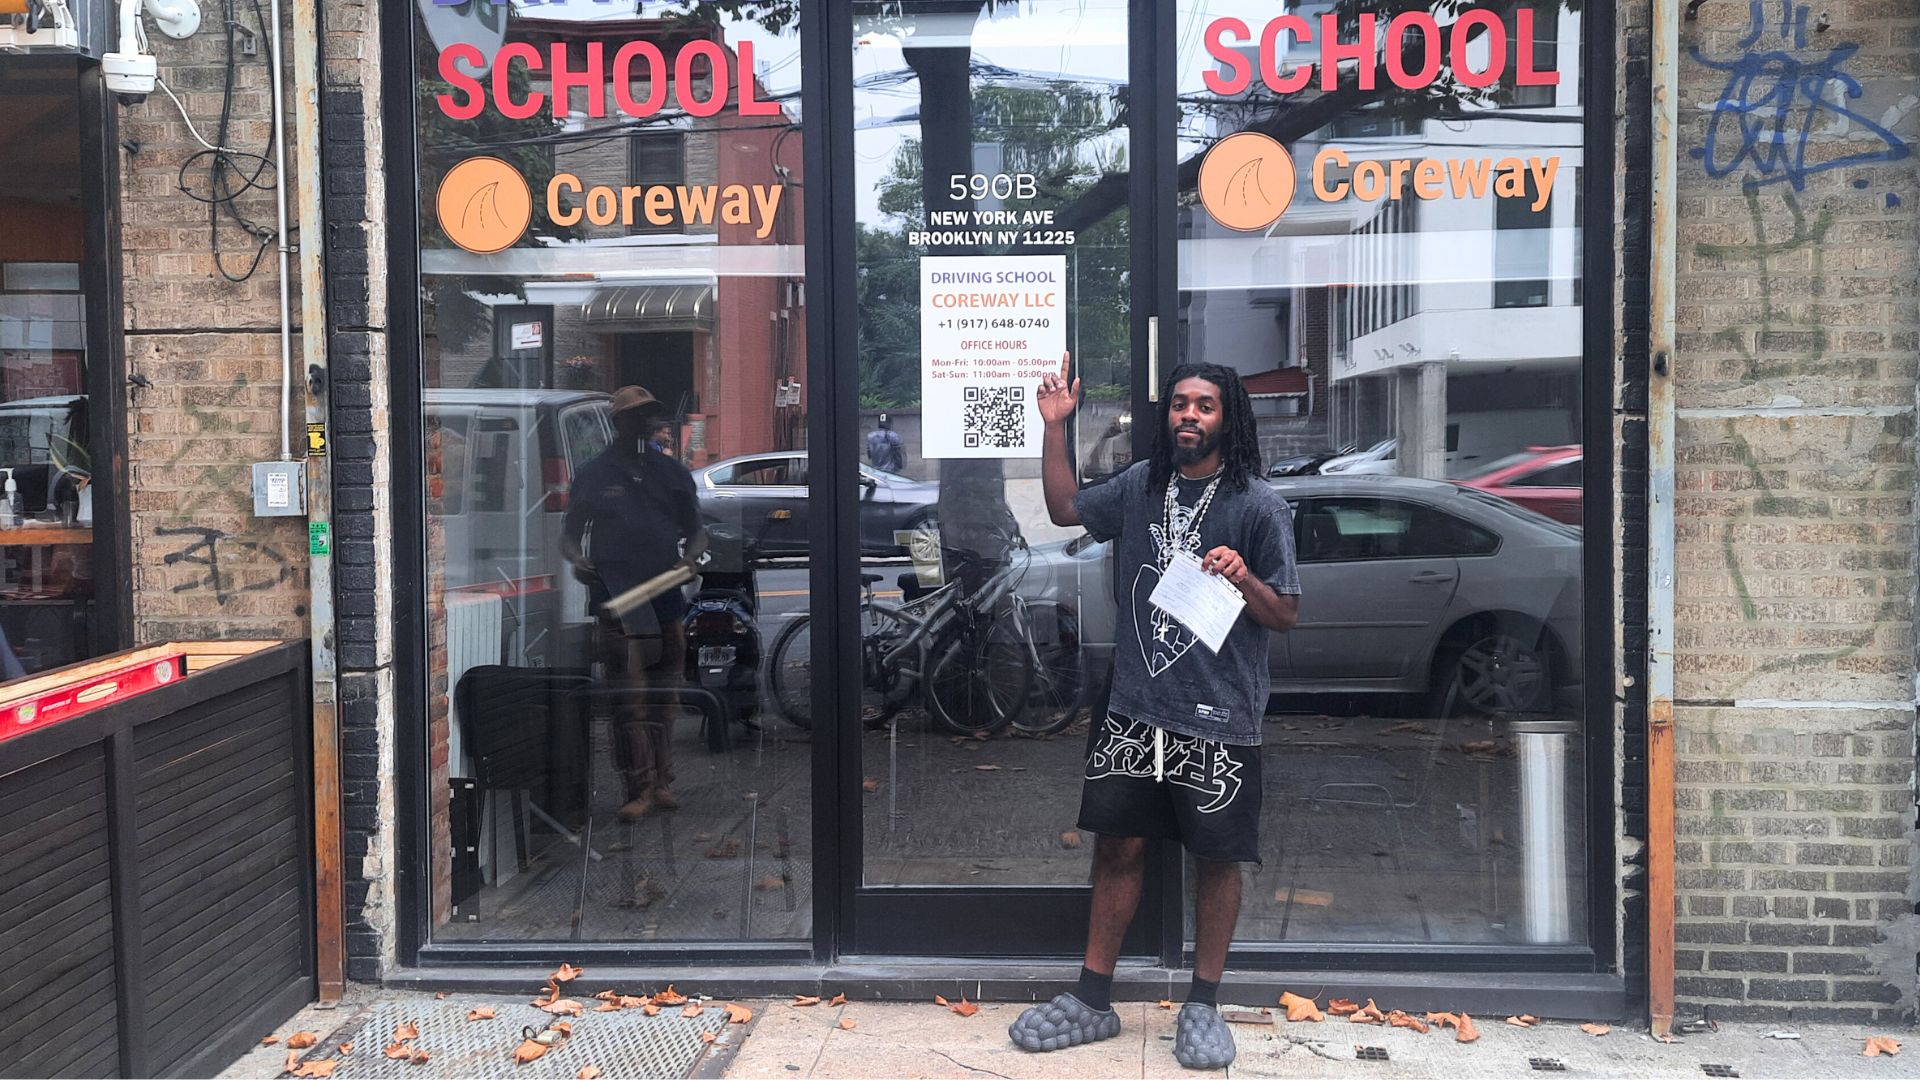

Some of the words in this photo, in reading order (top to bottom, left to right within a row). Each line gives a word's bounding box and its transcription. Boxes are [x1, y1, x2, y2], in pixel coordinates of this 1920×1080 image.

[1202, 8, 1560, 95] SCHOOL
[436, 39, 781, 120] SCHOOL
[950, 173, 1037, 200] 590B
[1312, 148, 1560, 212] Coreway
[547, 173, 783, 239] Coreway
[930, 211, 968, 226] NEW
[972, 210, 1018, 225] YORK
[1022, 210, 1054, 225] AVE
[908, 231, 993, 245] BROOKLYN
[997, 231, 1020, 245] NY
[1022, 230, 1075, 245] 11225
[931, 271, 992, 284] DRIVING
[996, 271, 1056, 283] SCHOOL
[932, 293, 1019, 308] COREWAY
[1025, 292, 1055, 308] LLC
[938, 318, 952, 329] +1
[957, 318, 988, 330] (917)
[991, 318, 1050, 329] 648-0740
[960, 340, 993, 350] OFFICE
[995, 340, 1027, 350] HOURS
[931, 358, 969, 367] Mon-Fri:
[973, 358, 1011, 367] 10:00am
[931, 370, 969, 379] Sat-Sun:
[973, 370, 1011, 379] 11:00am
